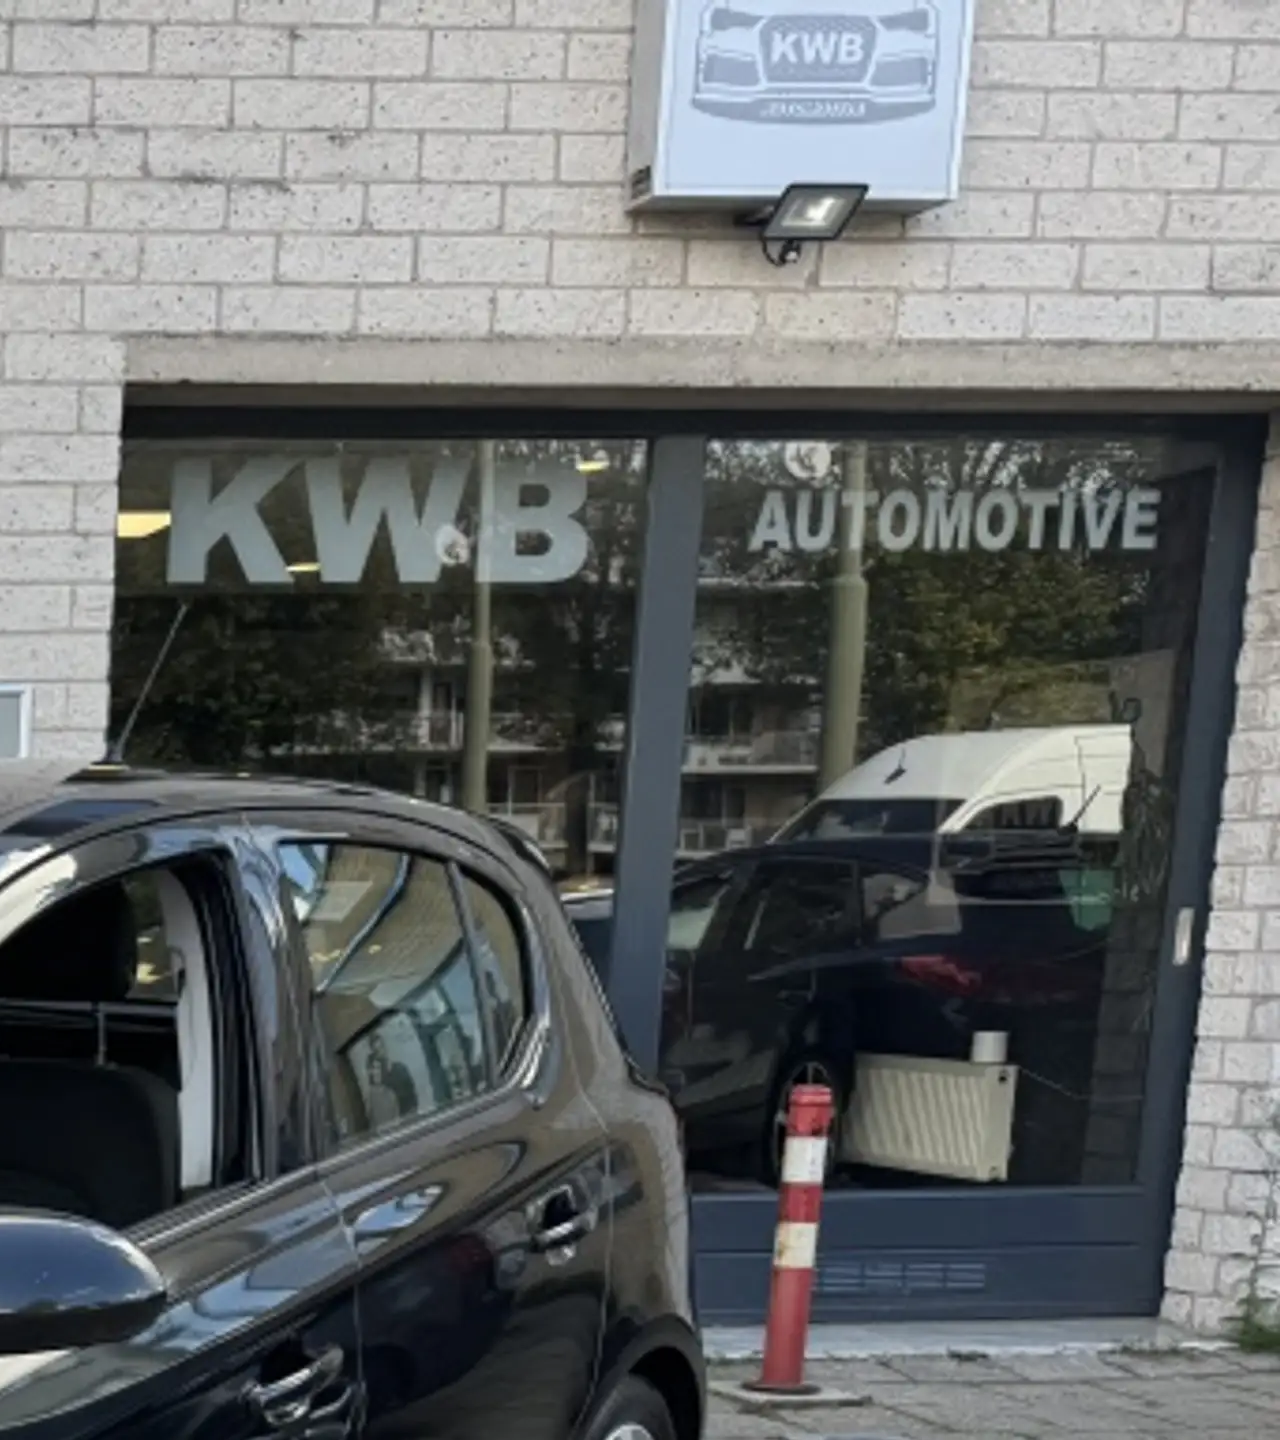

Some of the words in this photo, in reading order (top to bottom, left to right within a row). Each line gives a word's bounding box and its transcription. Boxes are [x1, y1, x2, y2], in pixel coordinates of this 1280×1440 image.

[770, 32, 864, 65] KWB
[166, 456, 590, 583] KWB
[747, 487, 1162, 552] AUTOMOTIVE
